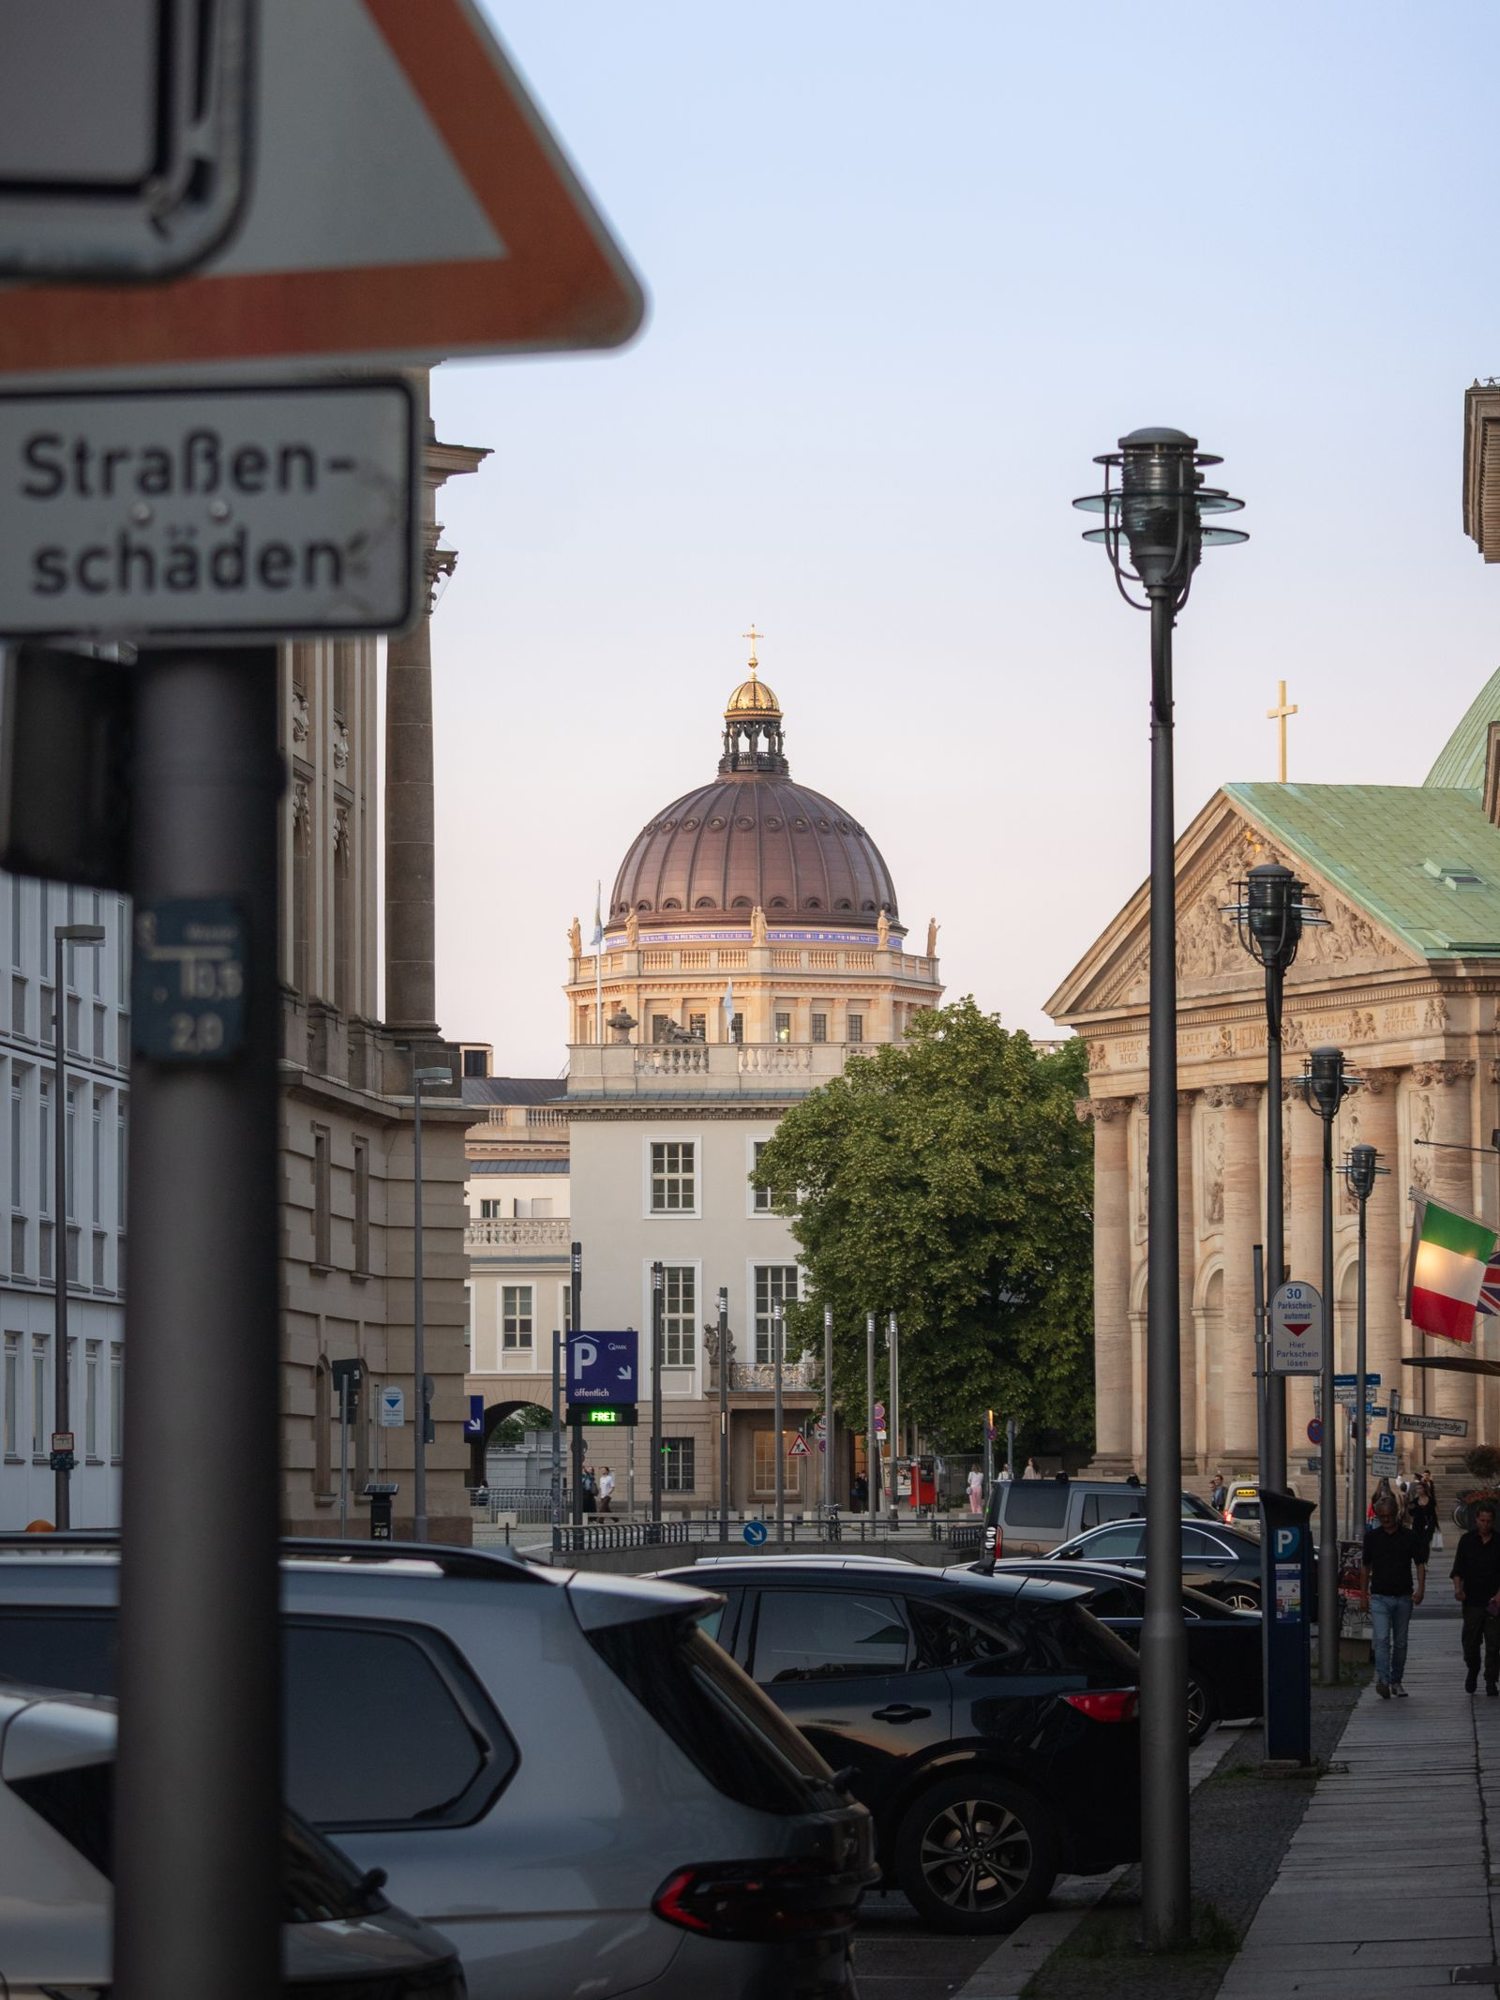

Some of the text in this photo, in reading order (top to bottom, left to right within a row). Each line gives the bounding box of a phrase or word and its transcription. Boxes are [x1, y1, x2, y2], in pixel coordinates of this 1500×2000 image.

[20, 426, 357, 501] Straßen-
[32, 522, 346, 595] schäden
[1286, 1288, 1302, 1299] 30
[1277, 1301, 1317, 1310] Parkschein-
[1284, 1312, 1311, 1320] automat
[1276, 1350, 1319, 1358] Parkschein
[574, 1342, 598, 1380] P
[1287, 1359, 1309, 1367] lösen
[574, 1387, 610, 1397] öffentlich
[591, 1412, 616, 1422] FREI
[1381, 1436, 1391, 1451] P
[1277, 1530, 1293, 1553] P
